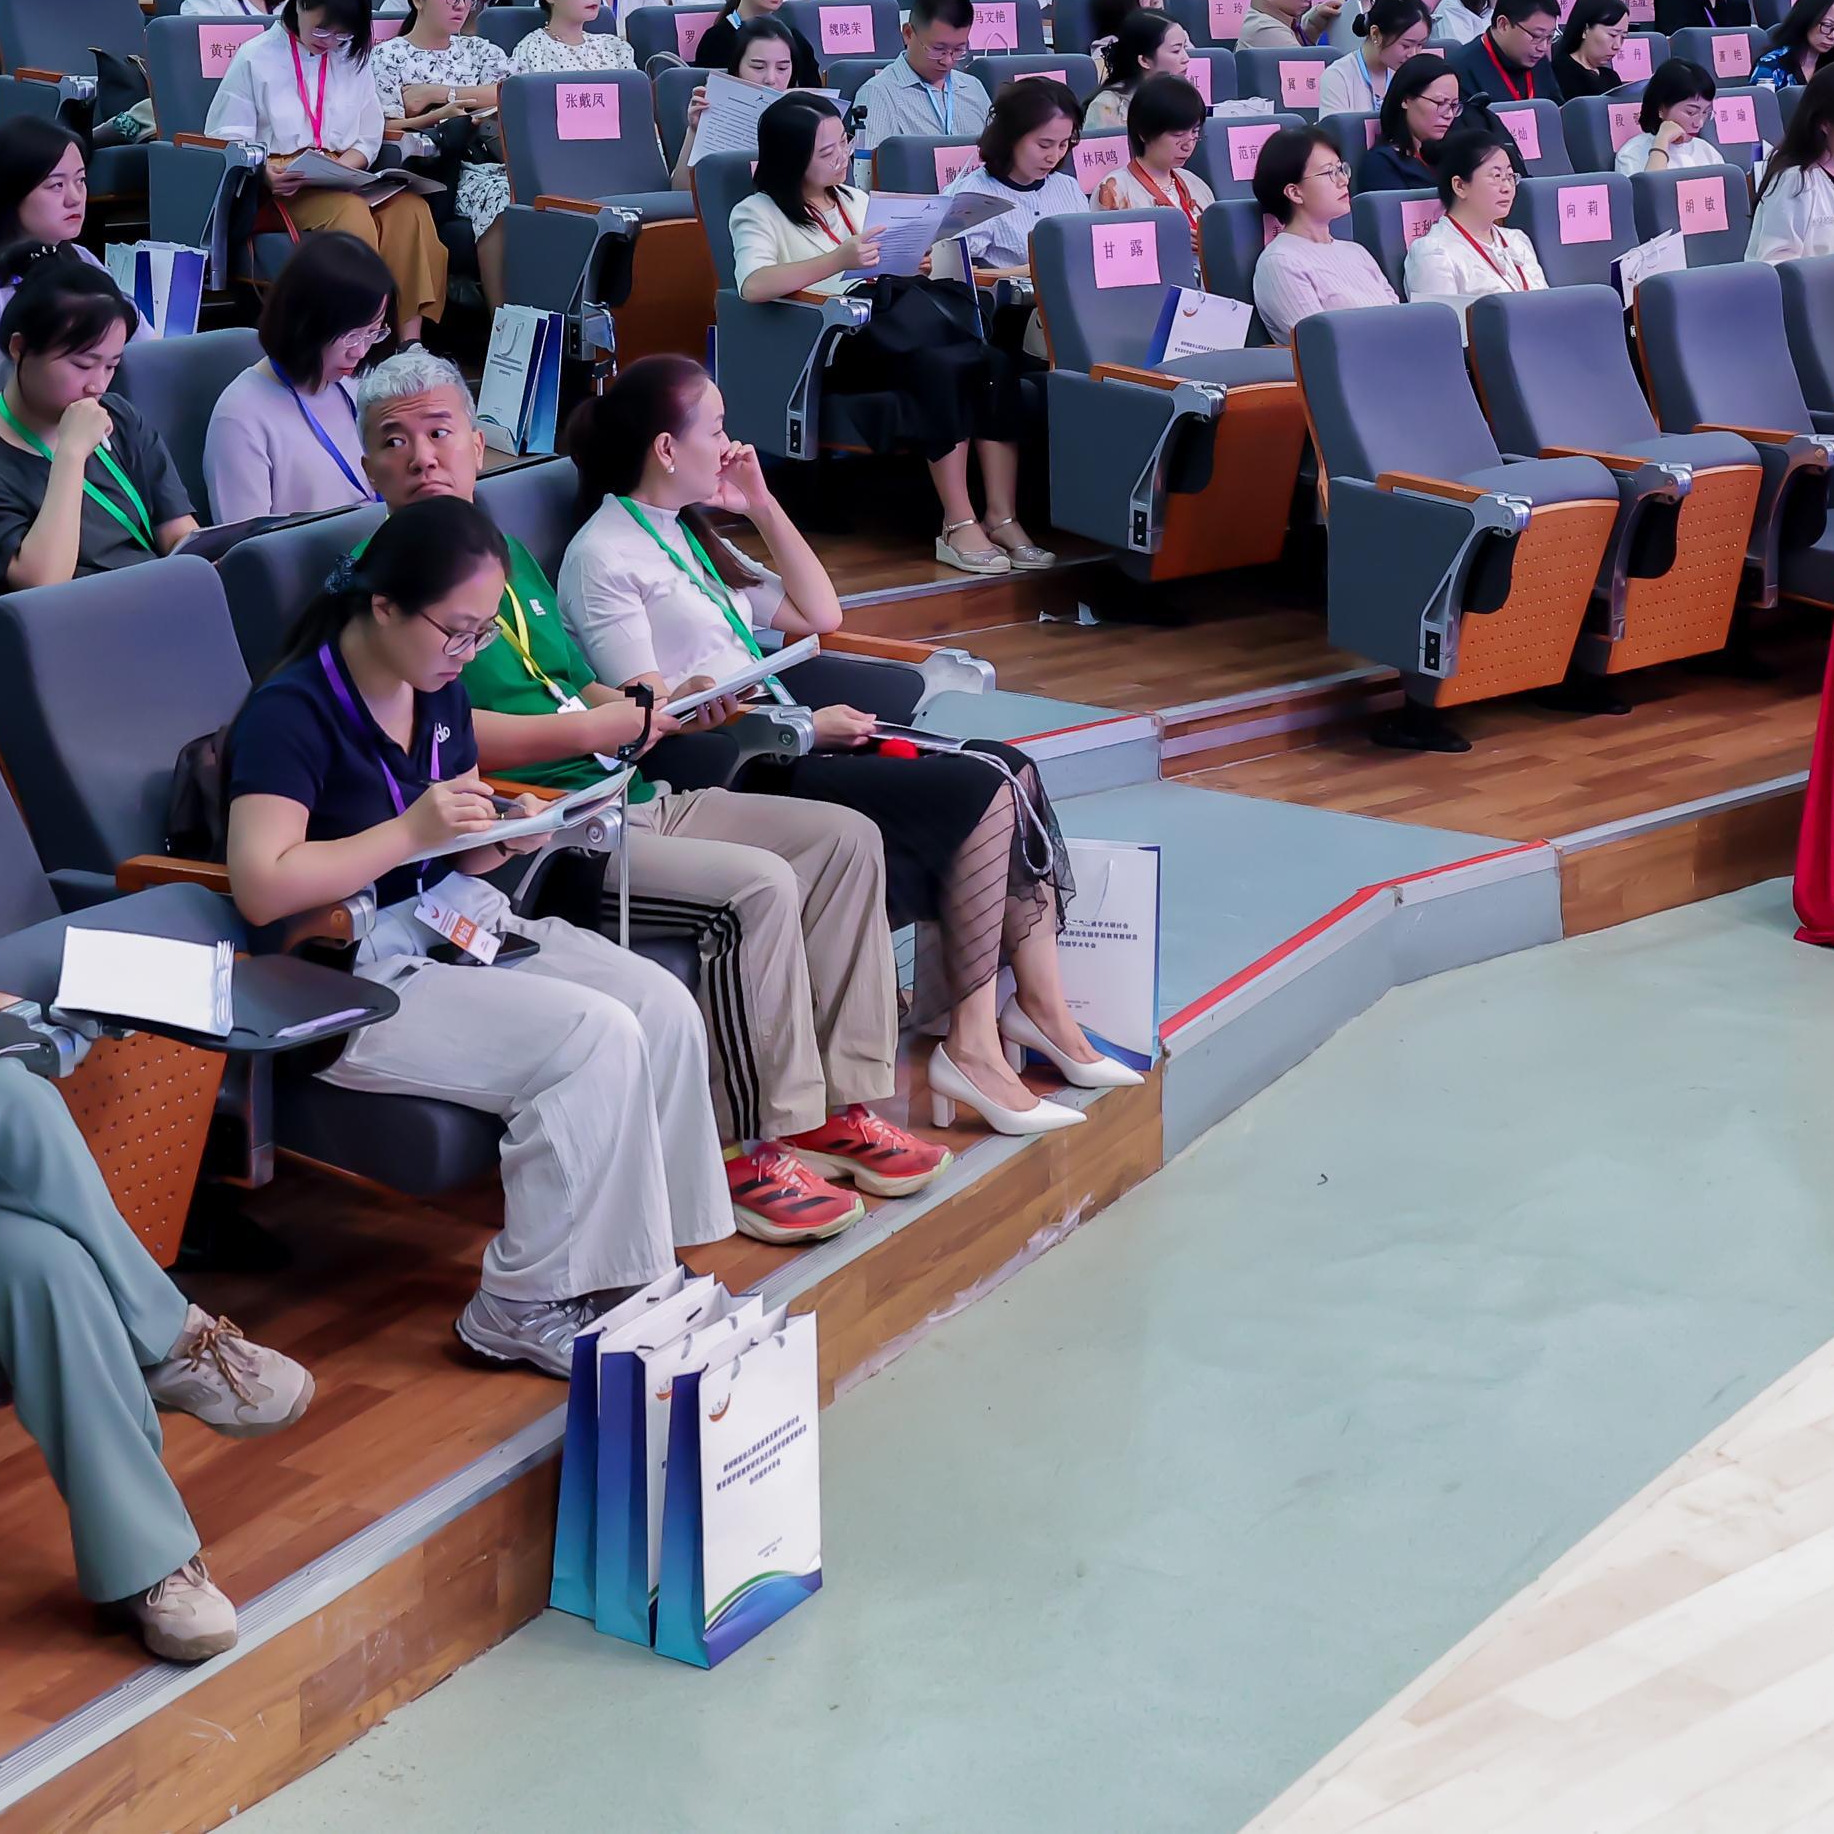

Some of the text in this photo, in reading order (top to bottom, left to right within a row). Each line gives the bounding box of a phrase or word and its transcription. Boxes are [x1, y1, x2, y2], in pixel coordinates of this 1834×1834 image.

[828, 21, 863, 36] 魏晓荣
[209, 43, 243, 59] 黄宁
[565, 92, 606, 109] 张戴凤
[1082, 149, 1118, 167] 林凤鸣
[1238, 144, 1261, 160] 范京
[1567, 200, 1599, 219] 向莉
[1103, 238, 1145, 260] 甘露
